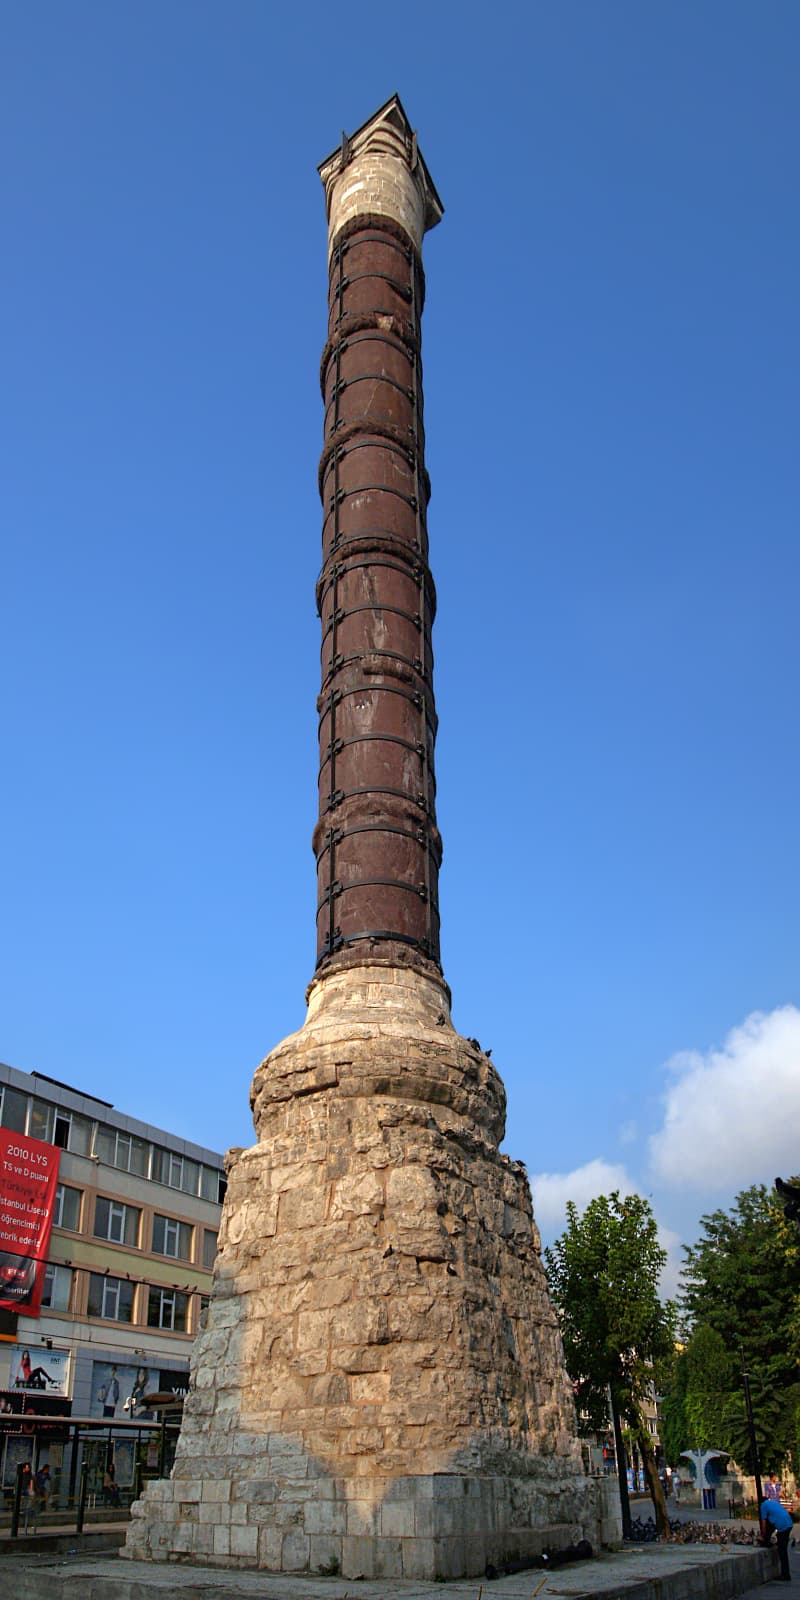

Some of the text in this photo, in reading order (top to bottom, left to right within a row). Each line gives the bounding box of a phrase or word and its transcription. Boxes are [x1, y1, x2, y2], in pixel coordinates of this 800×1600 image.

[7, 1144, 48, 1166] 2010 LYS
[3, 1161, 13, 1171] TS
[14, 1166, 22, 1174] ve
[0, 1232, 17, 1242] ebrik
